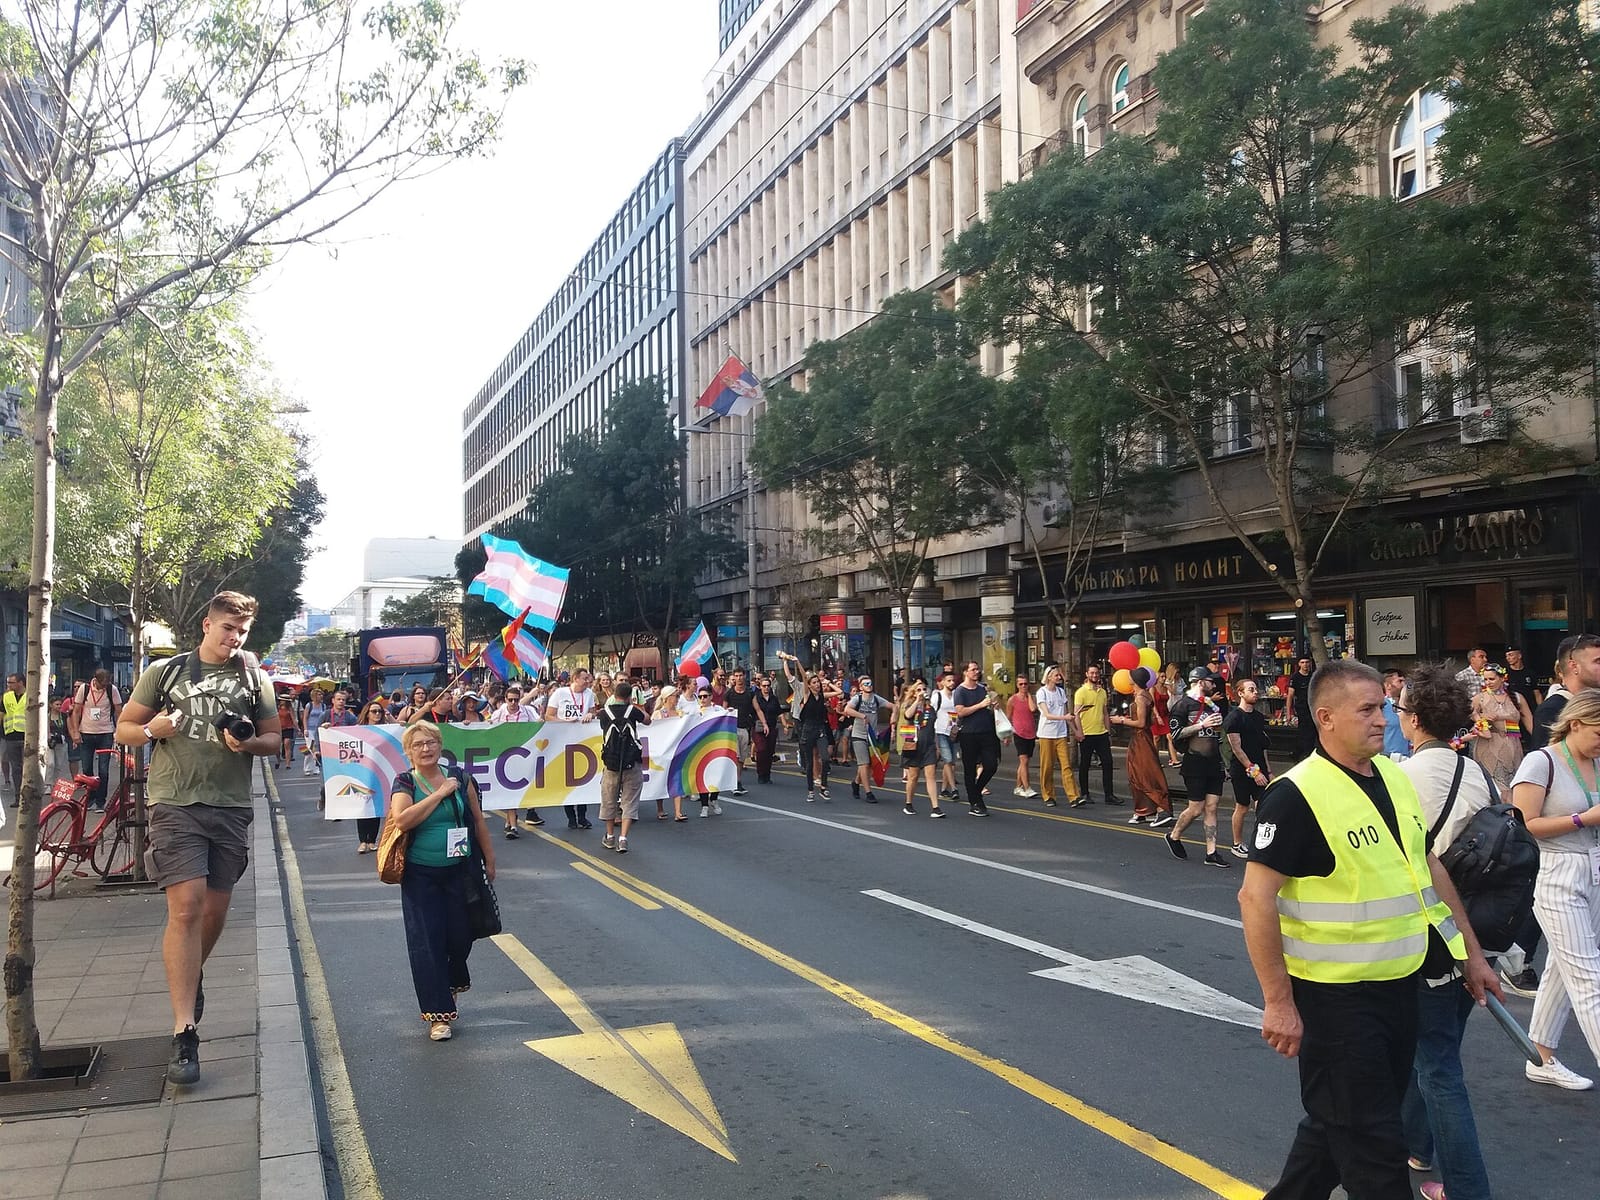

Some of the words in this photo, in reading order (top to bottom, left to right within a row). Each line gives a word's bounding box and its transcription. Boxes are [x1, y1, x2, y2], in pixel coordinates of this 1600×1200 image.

[1174, 555, 1242, 582] НОЛИТ
[338, 740, 359, 750] RECI
[339, 741, 365, 760] DA!
[1347, 825, 1379, 849] 010
